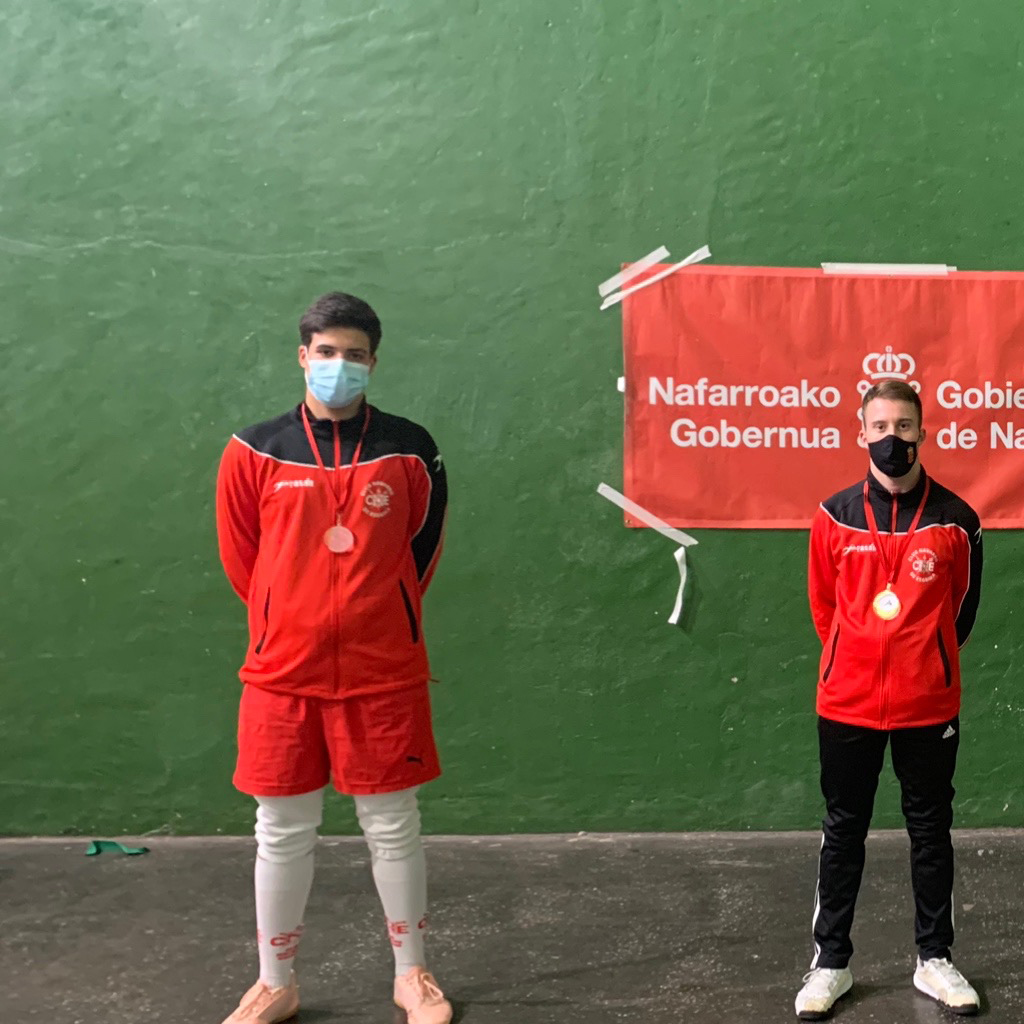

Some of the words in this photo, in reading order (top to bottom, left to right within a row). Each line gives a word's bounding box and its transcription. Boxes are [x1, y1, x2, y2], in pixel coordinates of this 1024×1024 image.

[648, 376, 841, 408] Nafarroako
[670, 417, 841, 449] Gobernua
[936, 421, 978, 450] de
